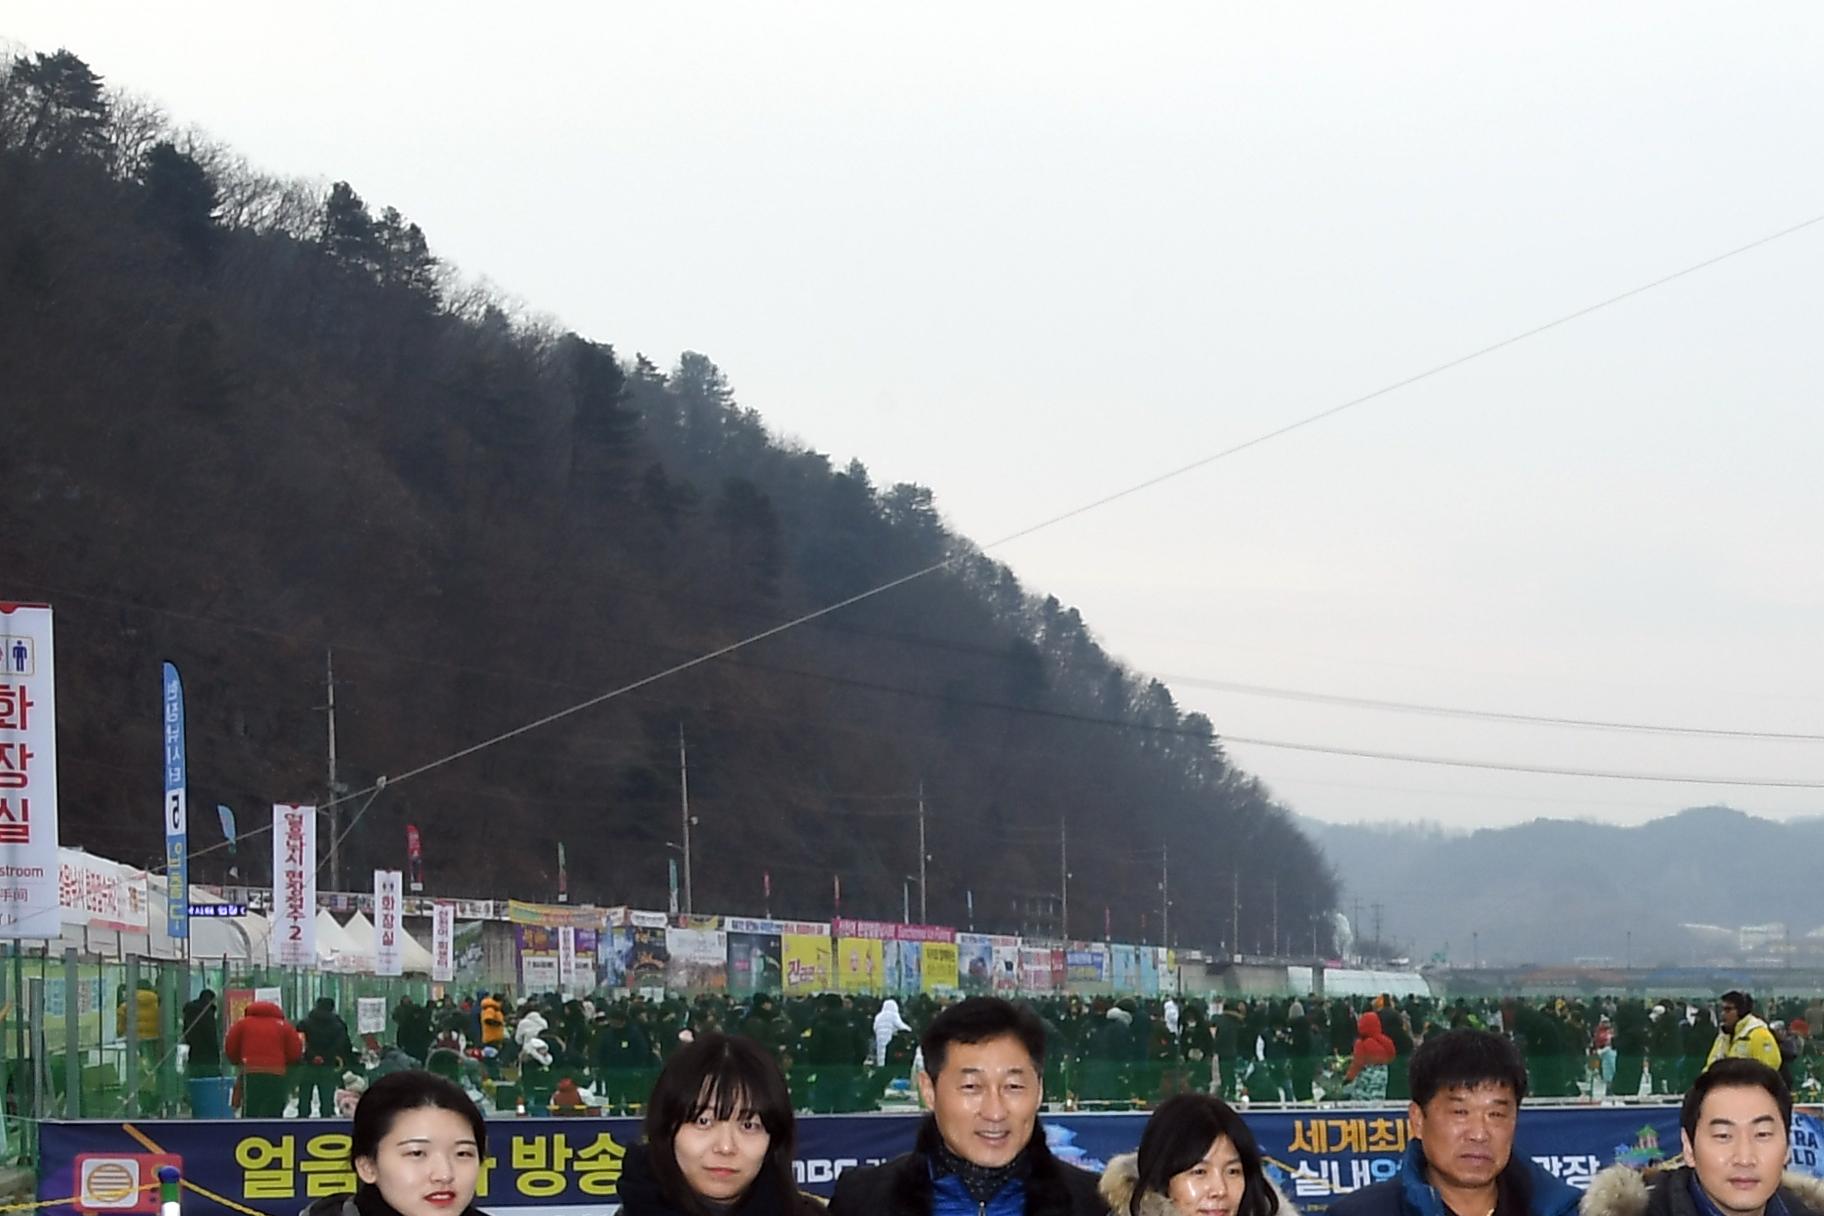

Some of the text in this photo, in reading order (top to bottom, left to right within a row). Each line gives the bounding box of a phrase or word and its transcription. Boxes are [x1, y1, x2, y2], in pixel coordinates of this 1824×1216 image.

[0, 685, 34, 844] 화장실
[289, 925, 303, 941] 2
[1287, 1118, 1411, 1154] 세계최
